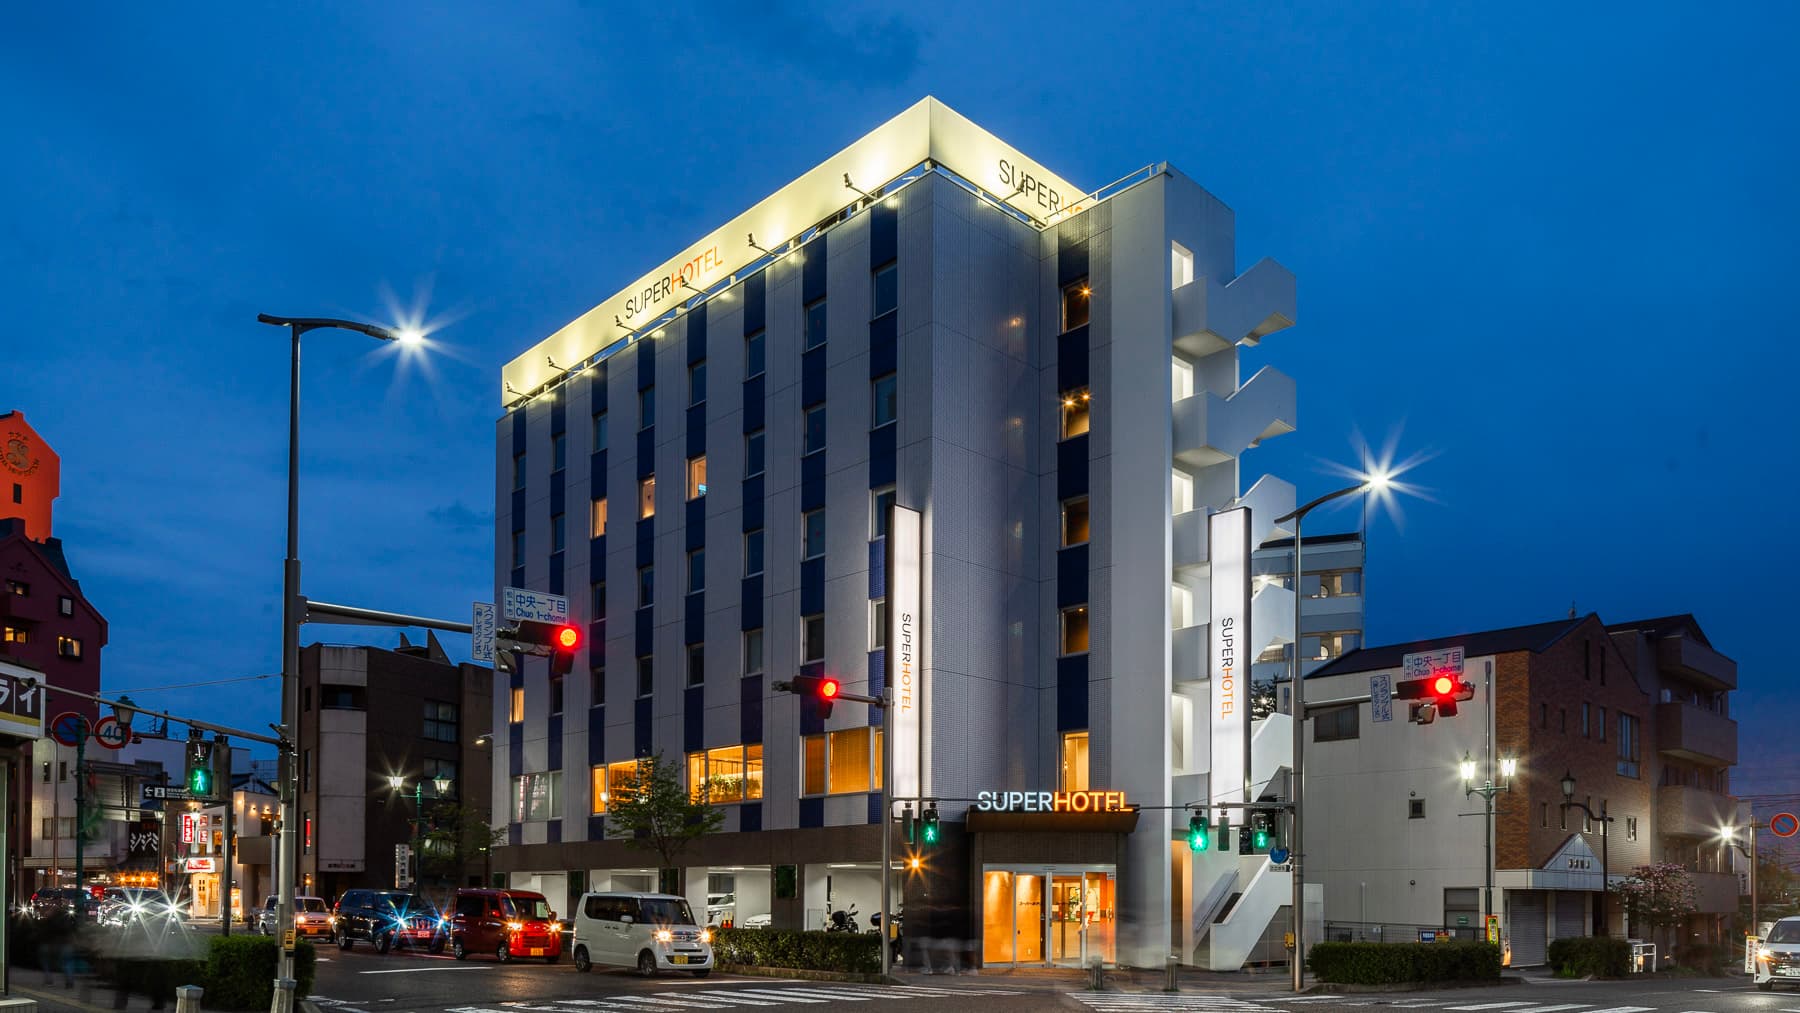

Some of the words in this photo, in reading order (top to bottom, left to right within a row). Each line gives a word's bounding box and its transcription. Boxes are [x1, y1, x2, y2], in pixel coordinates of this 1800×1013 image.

[625, 246, 723, 320] SUPERHOTEL
[515, 593, 566, 614] 中央一丁目
[515, 607, 533, 619] Chuo
[901, 612, 912, 713] SUPERHOTEL
[1221, 617, 1234, 721] SUPERHOTEL
[1413, 651, 1461, 668] 中央一丁目
[977, 791, 1133, 812] SUPERHOTEL
